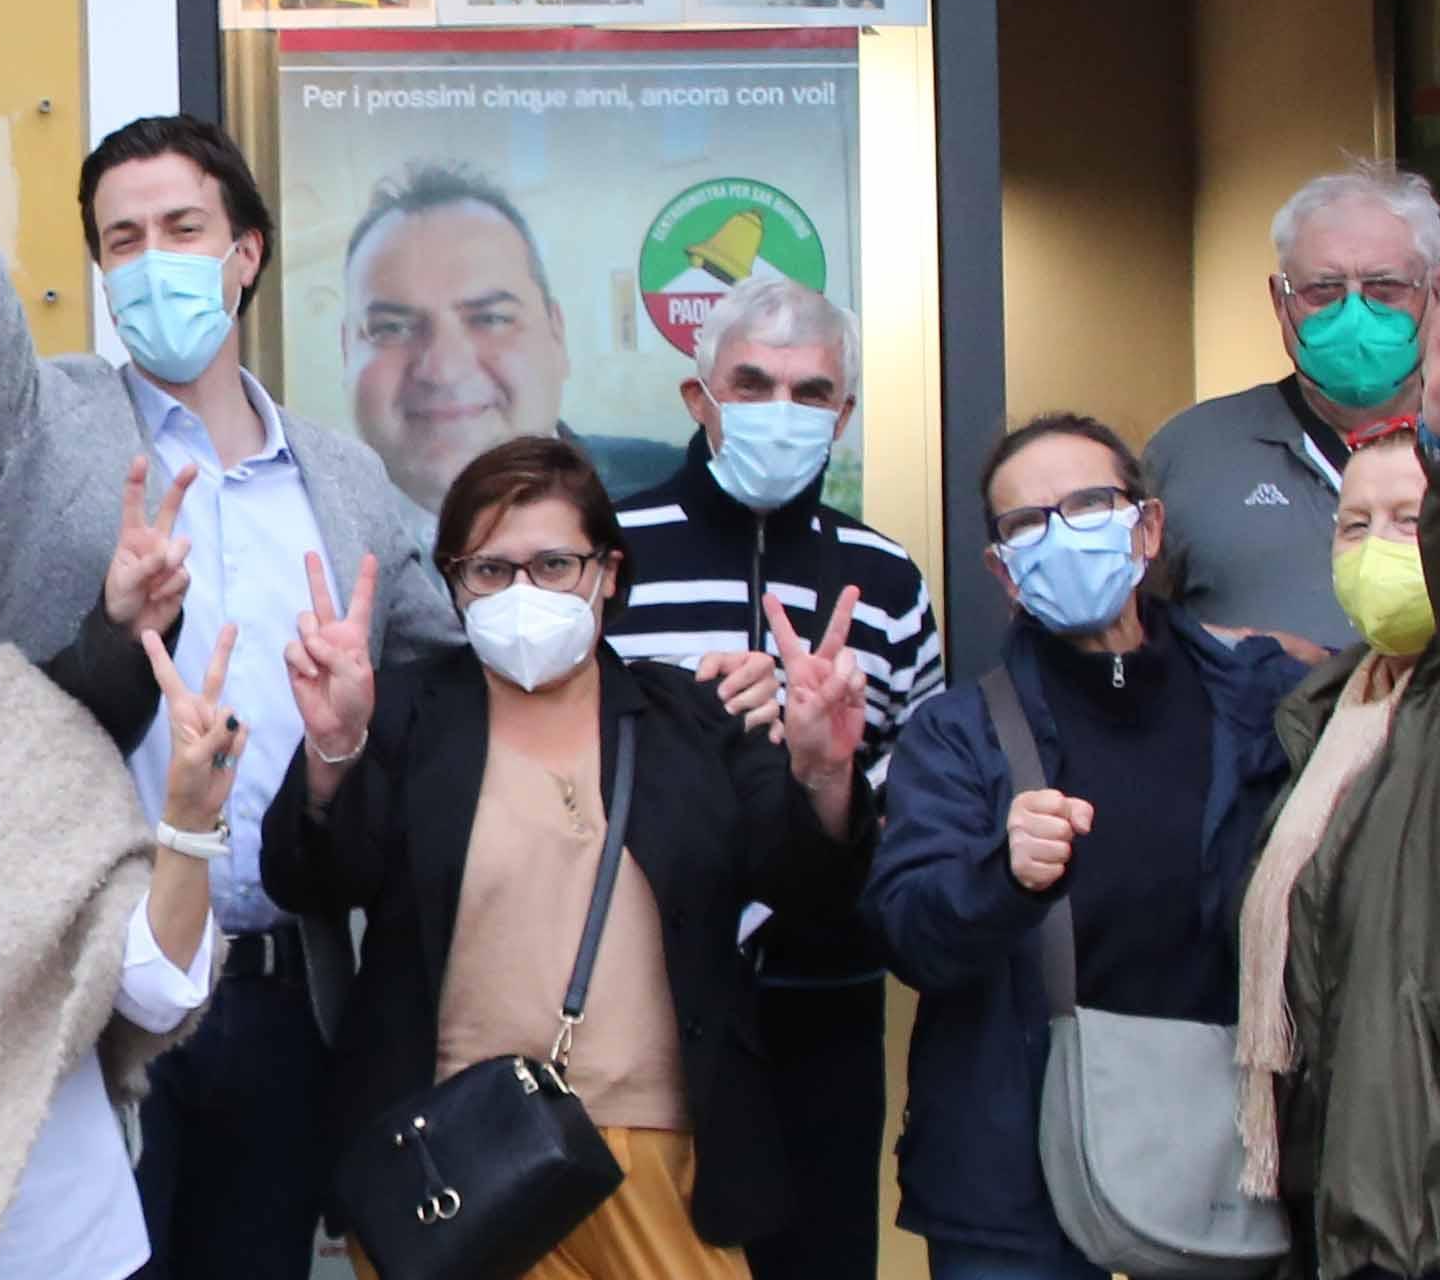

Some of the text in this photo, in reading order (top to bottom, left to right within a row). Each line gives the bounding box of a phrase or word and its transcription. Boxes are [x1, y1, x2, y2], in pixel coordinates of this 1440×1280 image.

[302, 81, 836, 116] Per i prossimi cinque anni, ancora con voi!
